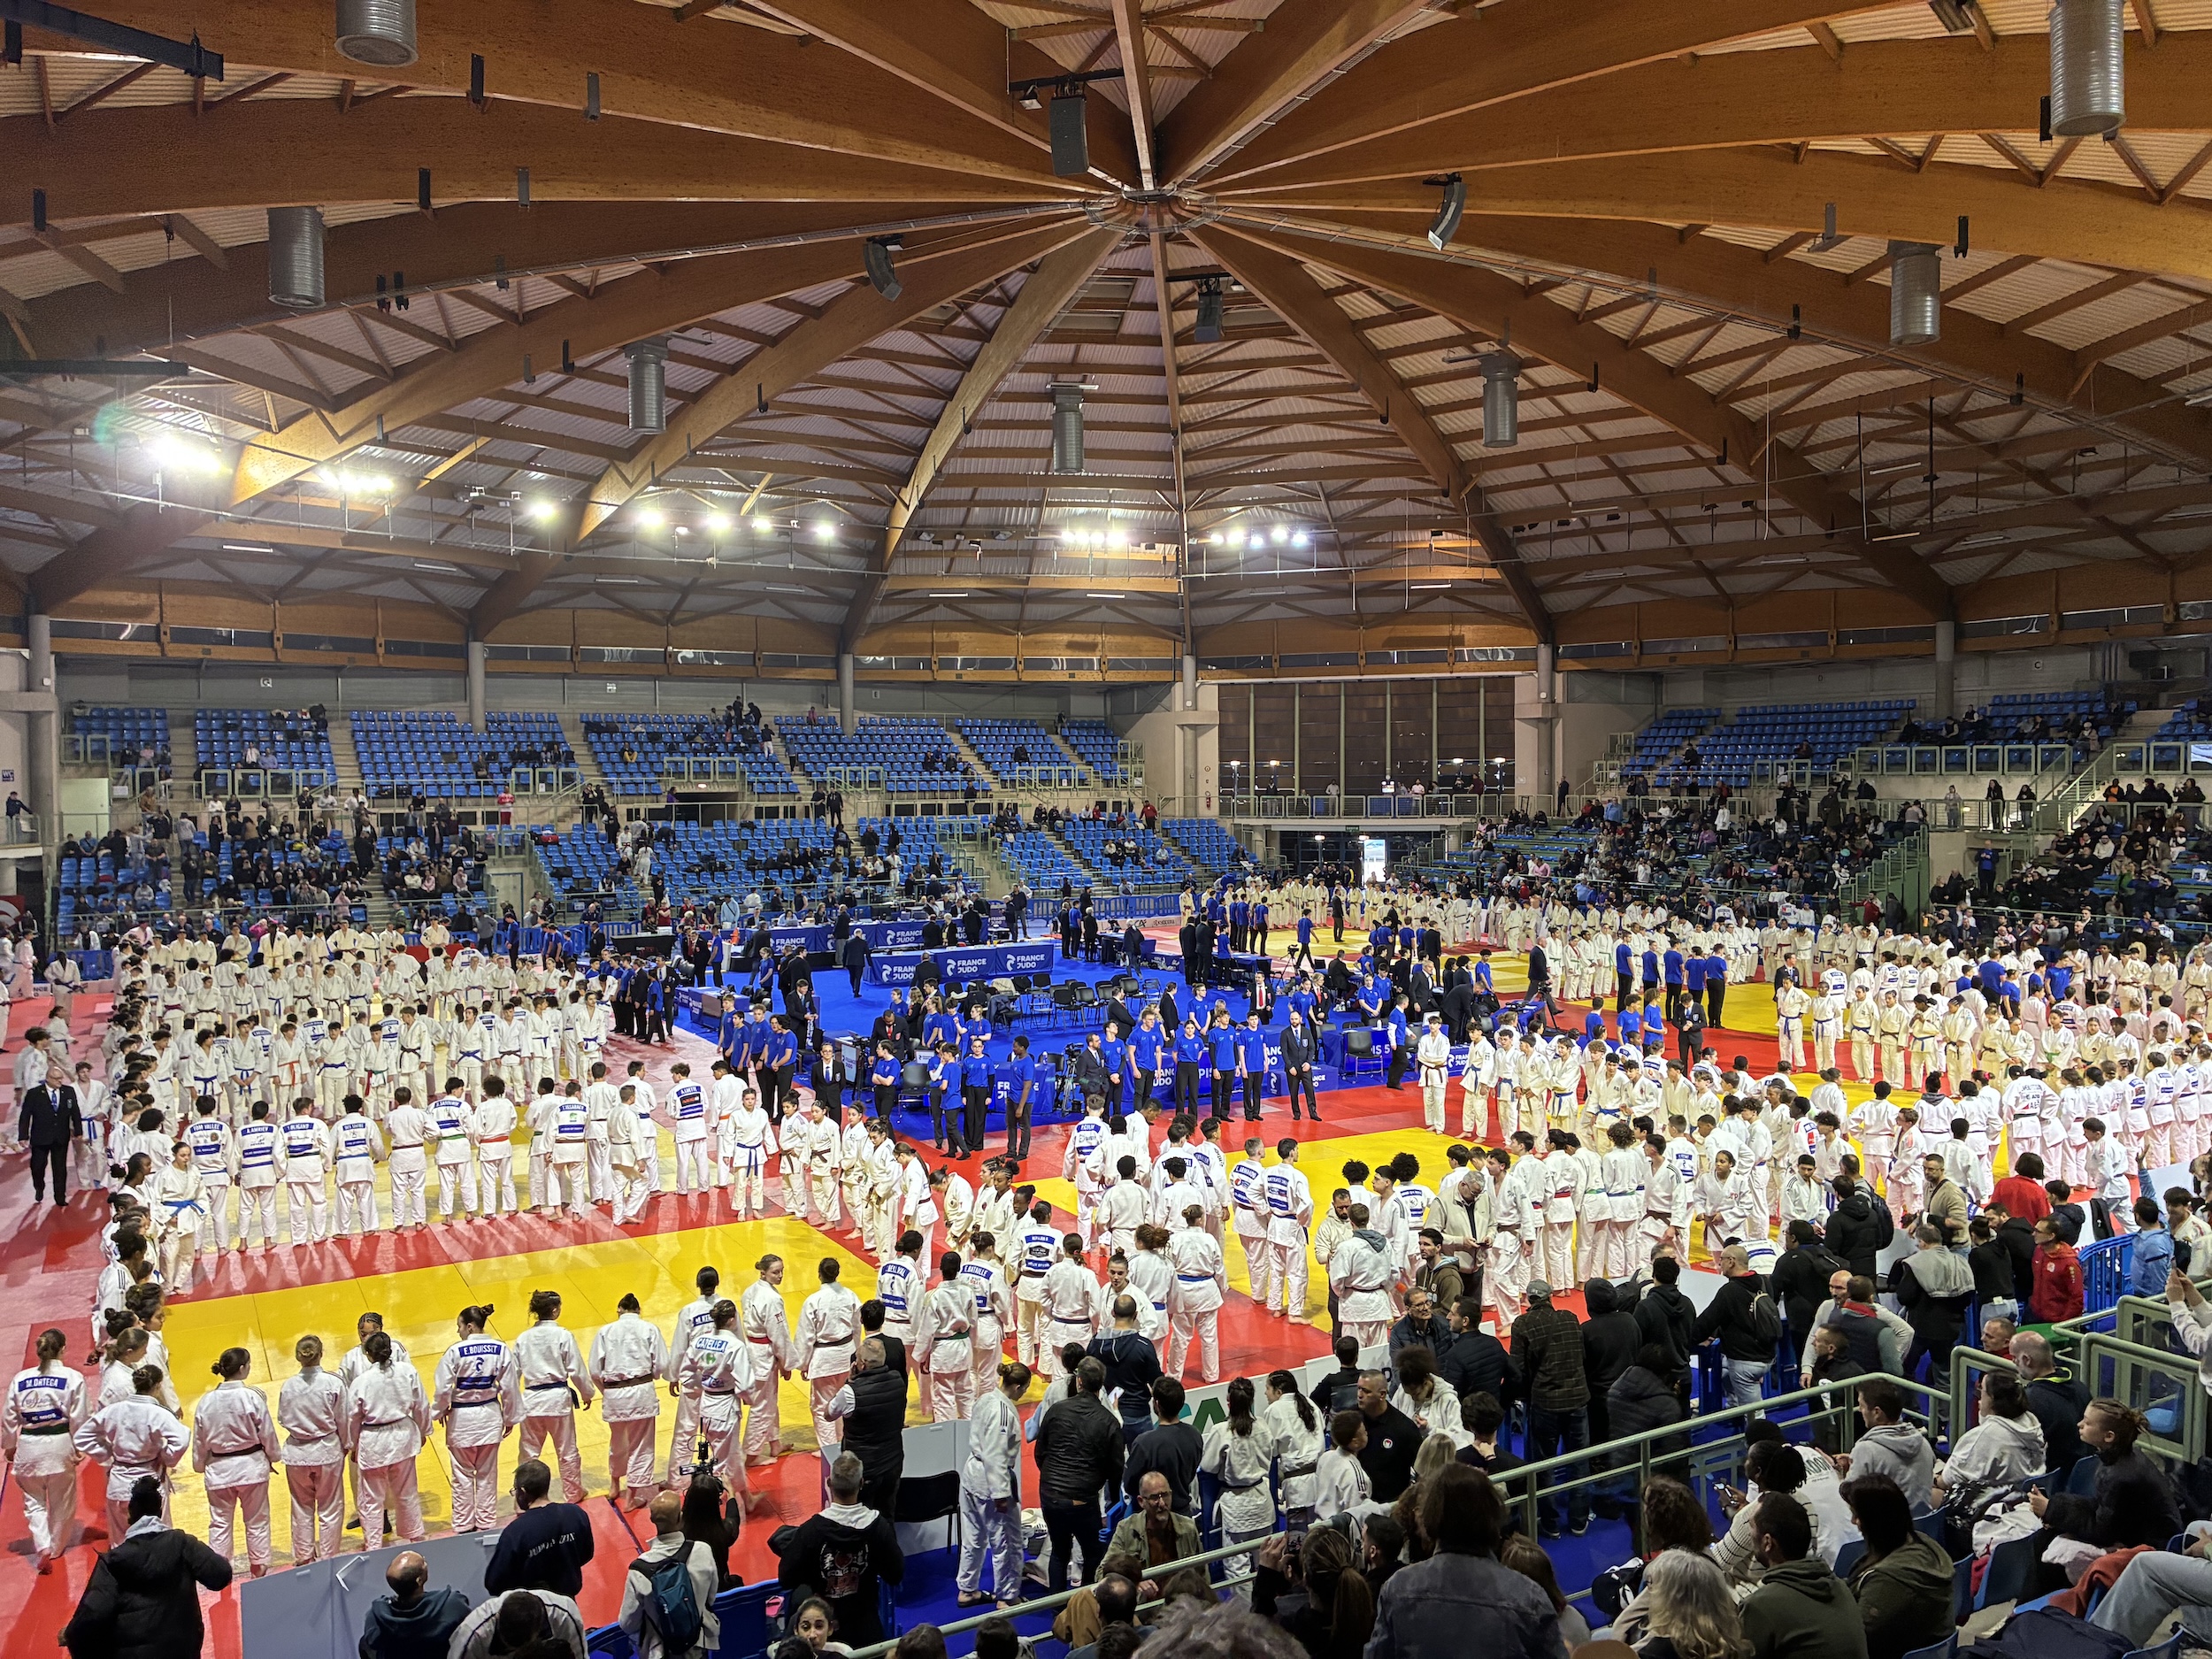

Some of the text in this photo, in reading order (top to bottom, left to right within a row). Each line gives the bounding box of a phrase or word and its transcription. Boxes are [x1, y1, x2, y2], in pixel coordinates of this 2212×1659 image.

[957, 958, 987, 967] FRANCE
[1017, 954, 1046, 963] FRANCE
[893, 965, 917, 974] FRAN
[1384, 1044, 1391, 1054] 5
[25, 1378, 59, 1388] M.ORTEGA
